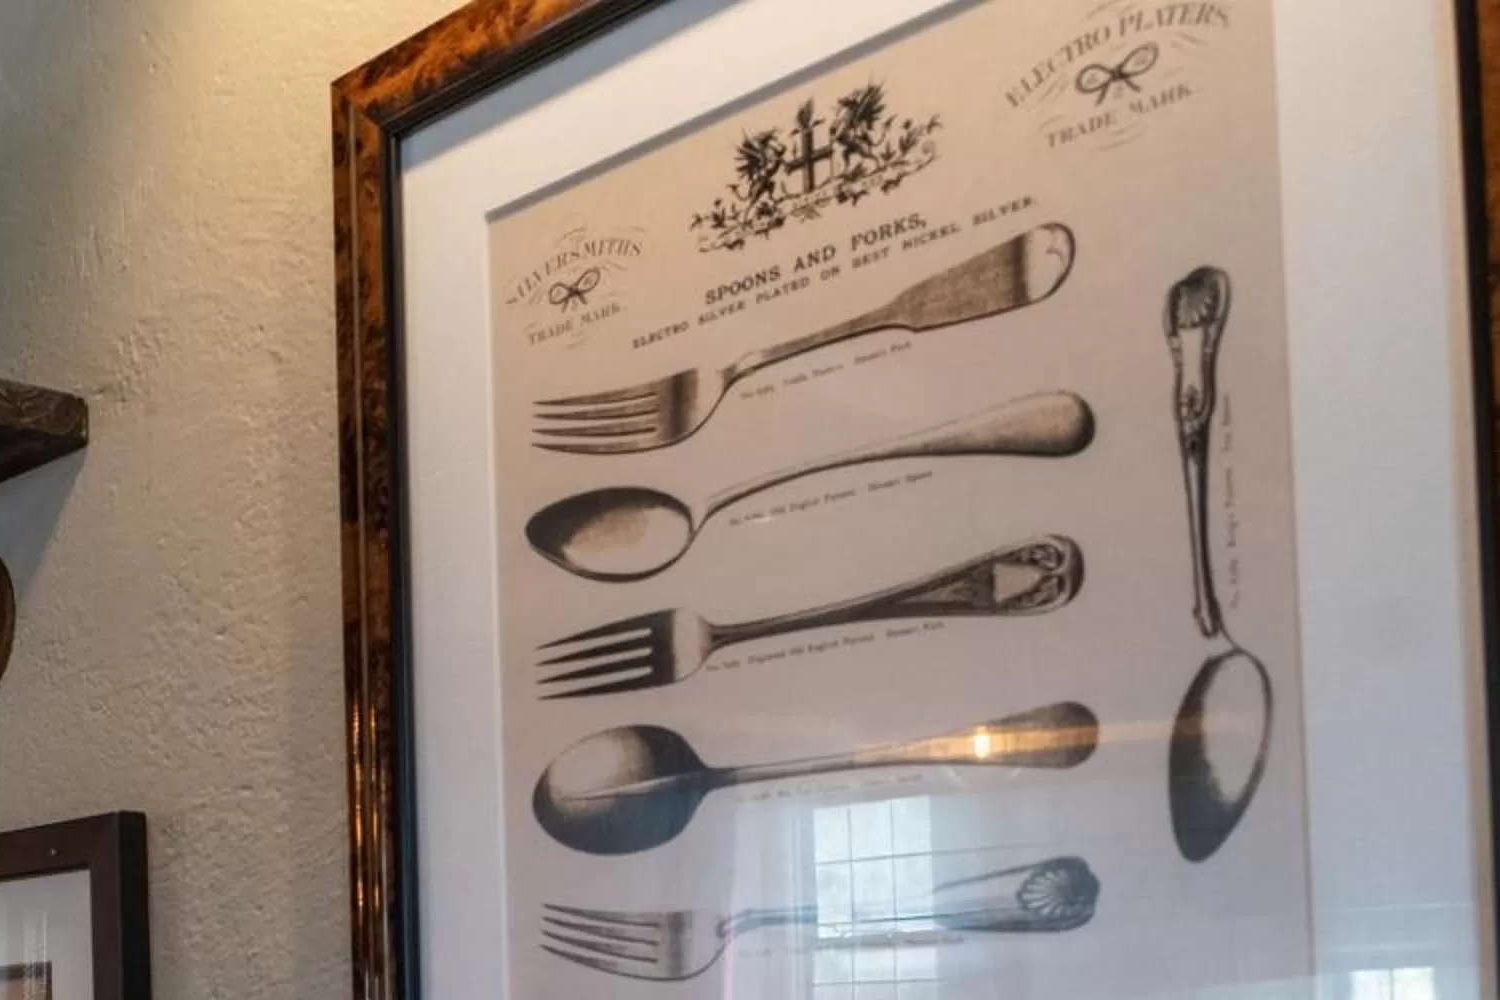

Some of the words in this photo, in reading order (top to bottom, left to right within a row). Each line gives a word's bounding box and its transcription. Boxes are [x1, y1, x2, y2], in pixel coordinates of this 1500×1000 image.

[1004, 24, 1112, 109] ELECTRO
[1118, 2, 1231, 37] PLATERS
[1046, 111, 1114, 149] TRADE
[1128, 83, 1194, 114] MARK
[631, 320, 690, 350] ELECTRO
[697, 300, 746, 326] SILVER
[755, 275, 811, 305] PLATED
[819, 265, 841, 281] ON
[851, 246, 890, 269] BEST
[901, 222, 961, 251] NICKEL
[971, 196, 1034, 227] SILVER
[704, 264, 782, 305] SPOONS
[792, 243, 838, 273] AND
[850, 212, 928, 252] FORKS,
